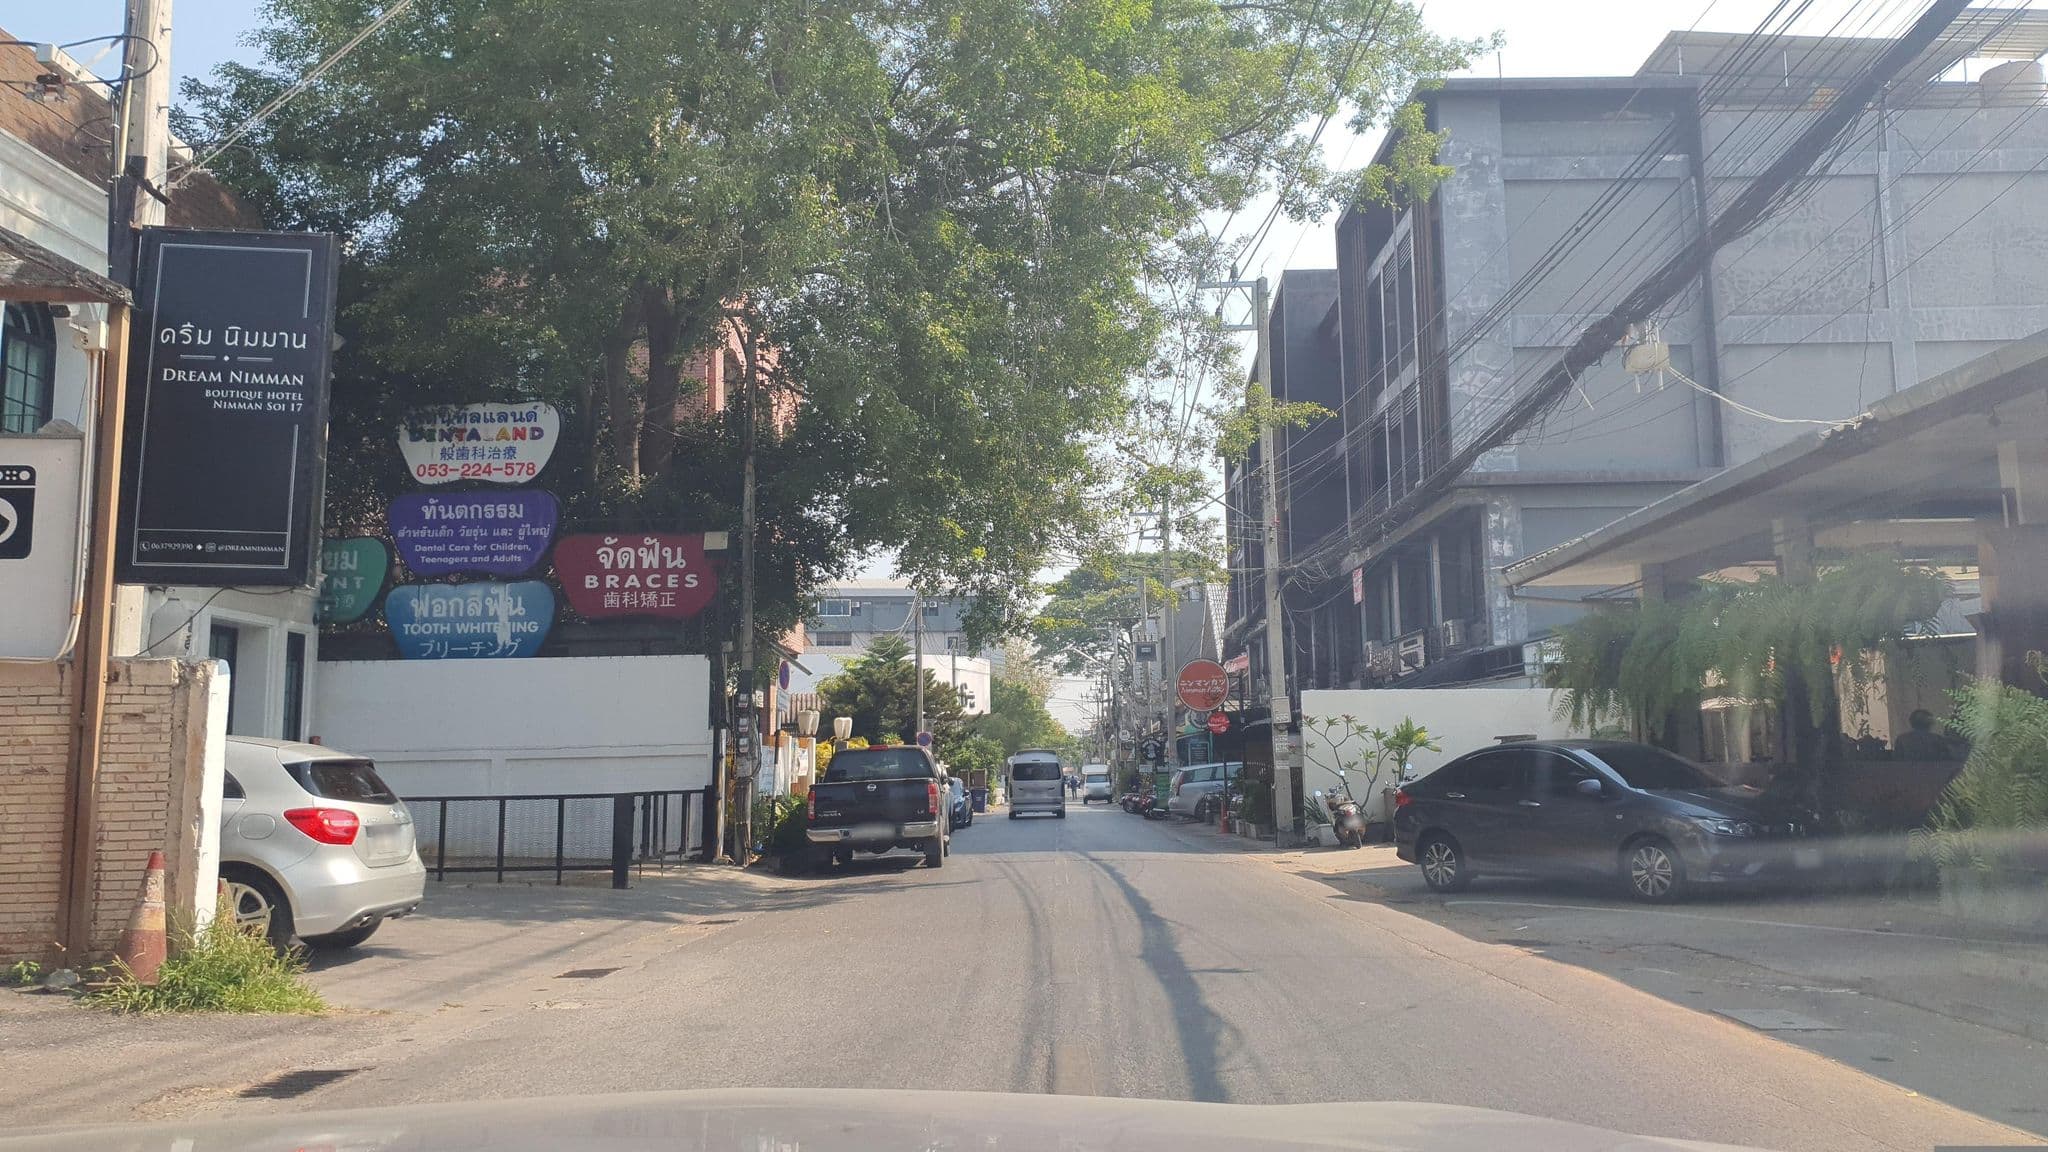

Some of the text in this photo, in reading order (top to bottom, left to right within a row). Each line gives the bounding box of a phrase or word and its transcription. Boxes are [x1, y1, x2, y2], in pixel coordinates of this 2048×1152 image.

[224, 326, 308, 349] นิมมาน
[162, 368, 304, 386] DREAM NIMMAN
[205, 389, 304, 401] BOUTIQUE HOTEL
[213, 401, 262, 410] NIMMAN
[291, 403, 303, 412] 17
[416, 462, 536, 478] 053-224-578
[421, 498, 524, 520] ทันตกรรม
[415, 544, 445, 552] Dental
[448, 544, 471, 552] Care
[473, 543, 487, 551] for
[596, 536, 687, 570] จัดฟัน
[420, 555, 522, 564] Teenagers and Adults
[585, 574, 699, 589] BRACES
[403, 623, 450, 634] TOOTH
